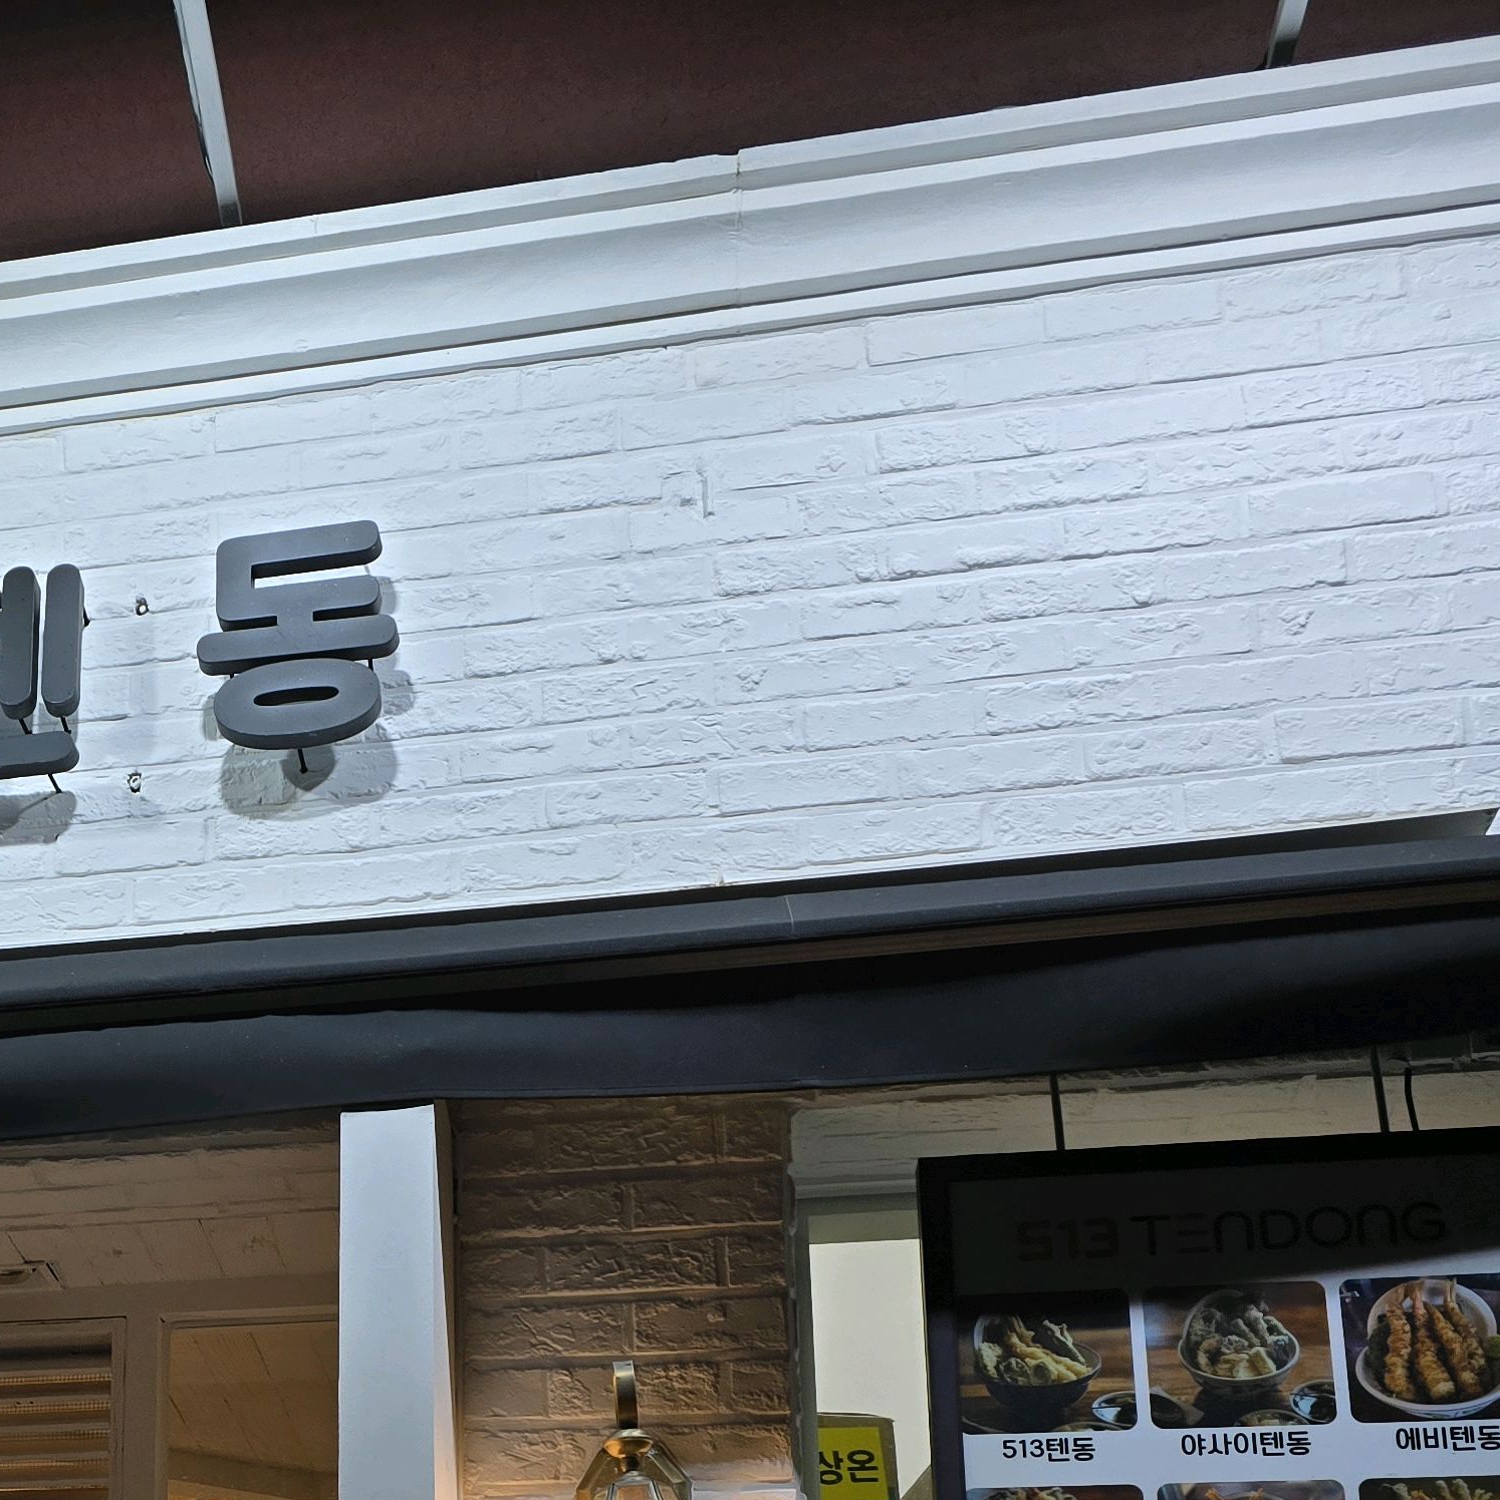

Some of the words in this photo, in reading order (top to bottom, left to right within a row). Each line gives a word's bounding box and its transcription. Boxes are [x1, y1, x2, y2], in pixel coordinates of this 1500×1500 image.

[1017, 1217, 1119, 1262] 513
[1002, 1437, 1096, 1463] 513텐동
[1181, 1431, 1312, 1457] 야사이텐동
[1395, 1426, 1500, 1452] 에비텐동
[819, 1449, 879, 1486] 상온
